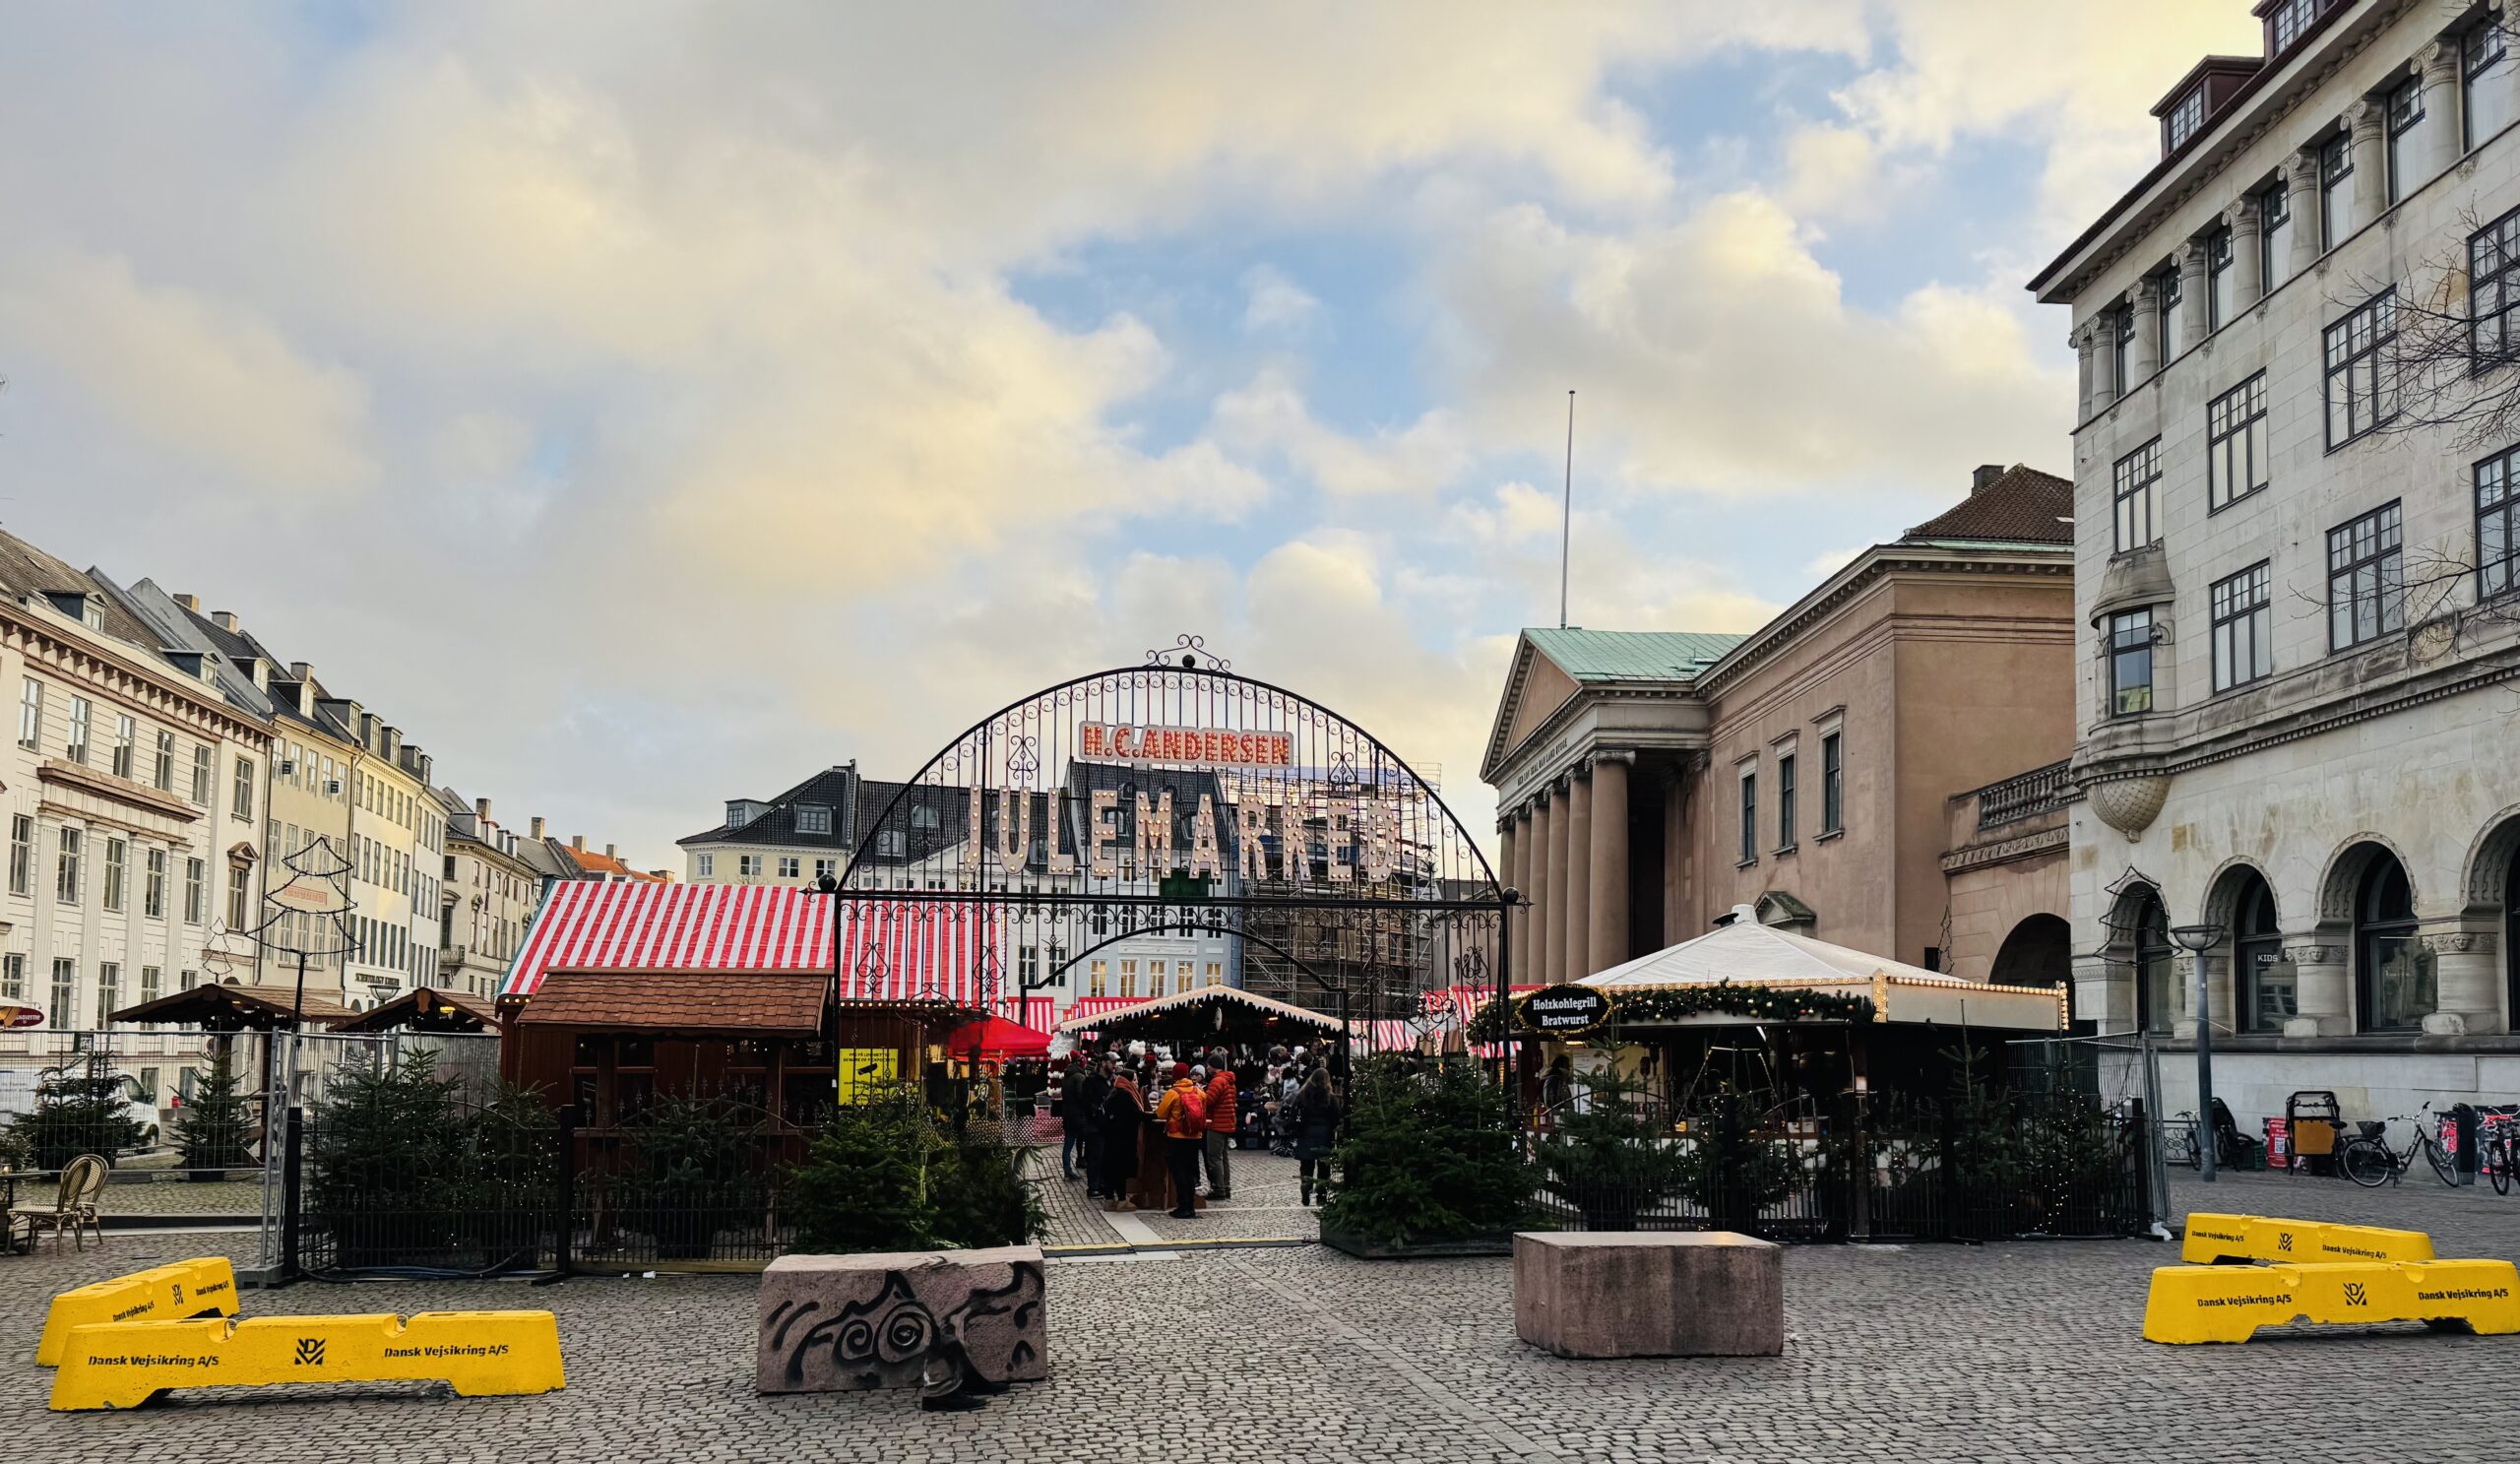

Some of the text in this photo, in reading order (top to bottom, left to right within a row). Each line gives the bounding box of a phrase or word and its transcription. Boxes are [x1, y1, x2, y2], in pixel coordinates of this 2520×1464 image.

[964, 784, 1397, 883] JULEMARKED
[1533, 996, 1598, 1011] Holzkohlegrill
[1542, 1014, 1590, 1027] Bratwurst
[2322, 1243, 2387, 1259] Dansk Vejsikring A/S
[2197, 1294, 2293, 1307] Dansk Vejsikring A/S
[2418, 1288, 2509, 1301] Dansk Vejsikring A/S
[384, 1344, 509, 1359] Dansk Vejsikring A/S
[88, 1354, 220, 1368] Dansk Vejsikring A/S
